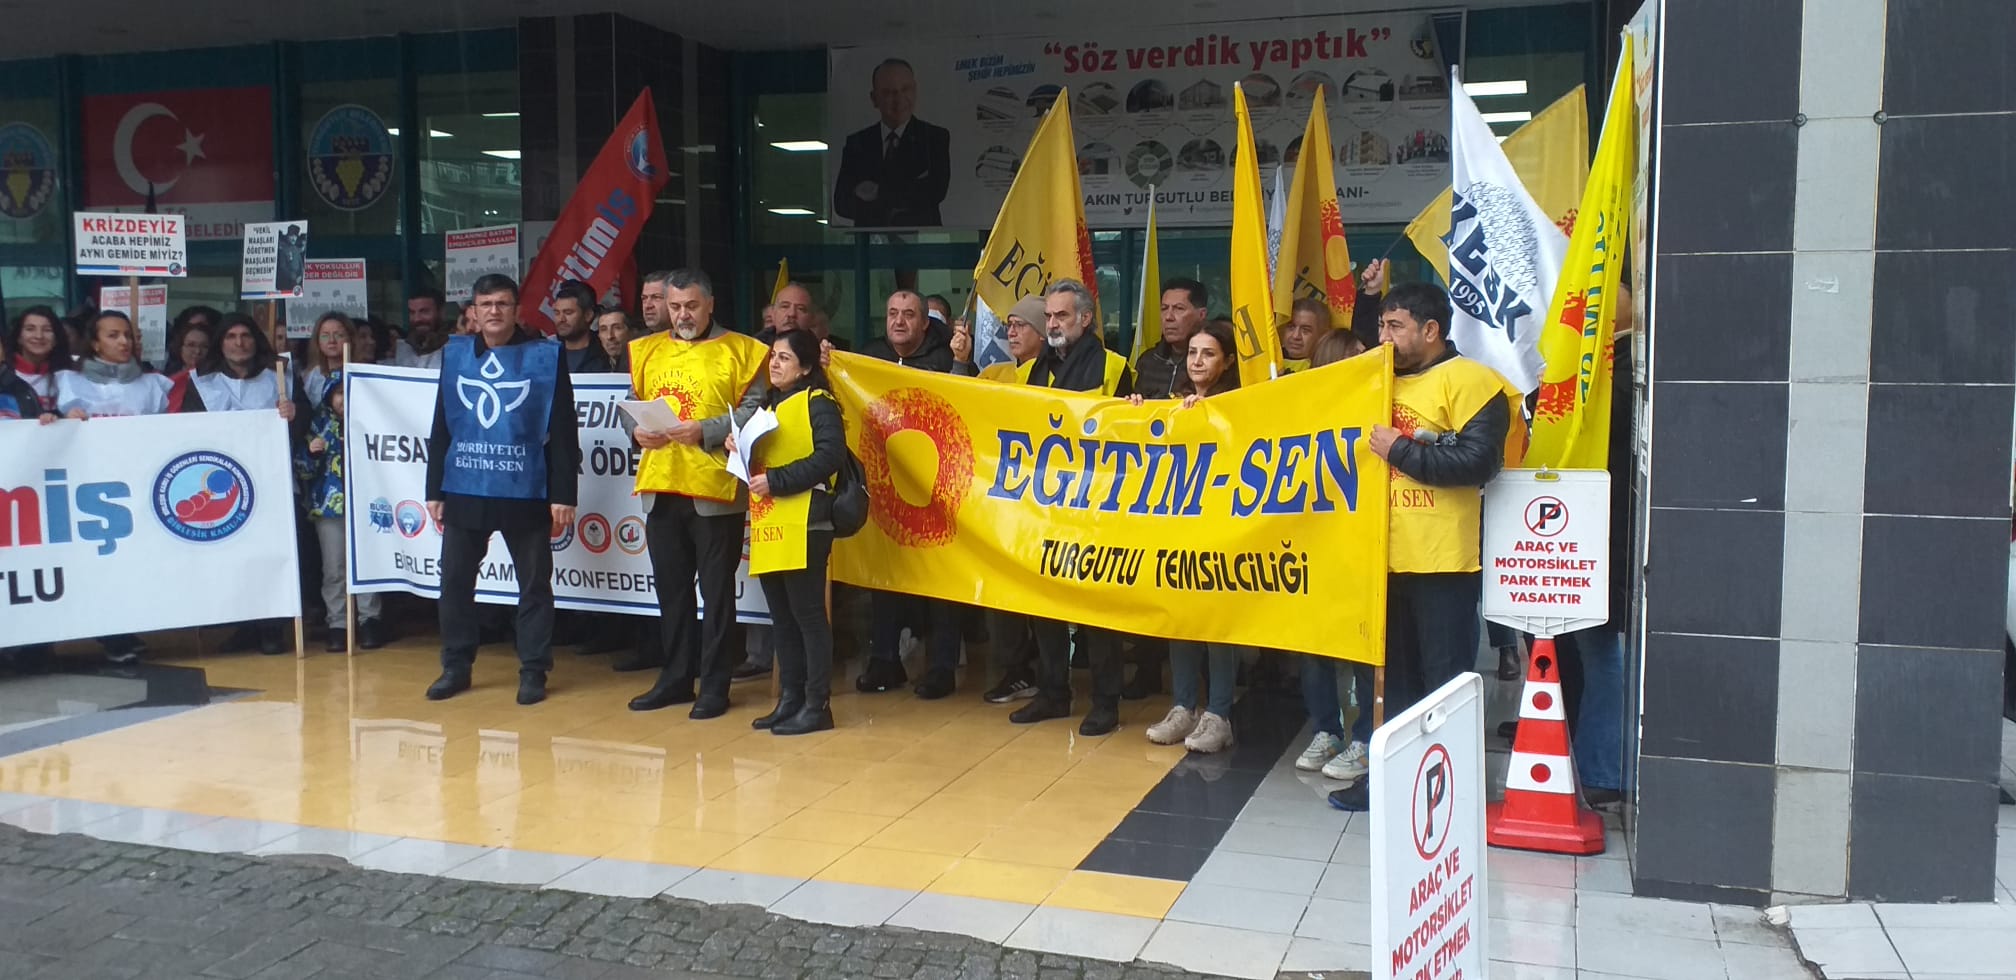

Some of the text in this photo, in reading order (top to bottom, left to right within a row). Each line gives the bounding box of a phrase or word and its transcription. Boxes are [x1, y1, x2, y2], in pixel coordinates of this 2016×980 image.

[1127, 34, 1240, 70] verdik
[1085, 191, 1121, 206] AKIN
[82, 216, 178, 234] KRİZDEYİZ
[91, 236, 171, 248] ACABA HEPİMİZ
[79, 248, 183, 261] AYNI GEMİDE MİYİZ?
[1450, 278, 1487, 315] 1995
[456, 455, 524, 472] EĞİTİM-SEN
[987, 413, 1362, 518] EĞİTİM-SEN
[1402, 488, 1435, 508] SEN
[763, 525, 784, 542] SEN
[1514, 541, 1578, 554] ARAÇ VE
[1040, 539, 1145, 586] TURGUTLU
[1495, 556, 1597, 571] MOTORSİKLET
[1499, 574, 1592, 588] PARK ETMEK
[1509, 591, 1582, 605] YASAKTIR
[1409, 846, 1461, 917] ARAÇ VE
[1392, 874, 1475, 977] MOTORSİKLET
[1433, 917, 1472, 978] ETMEK
